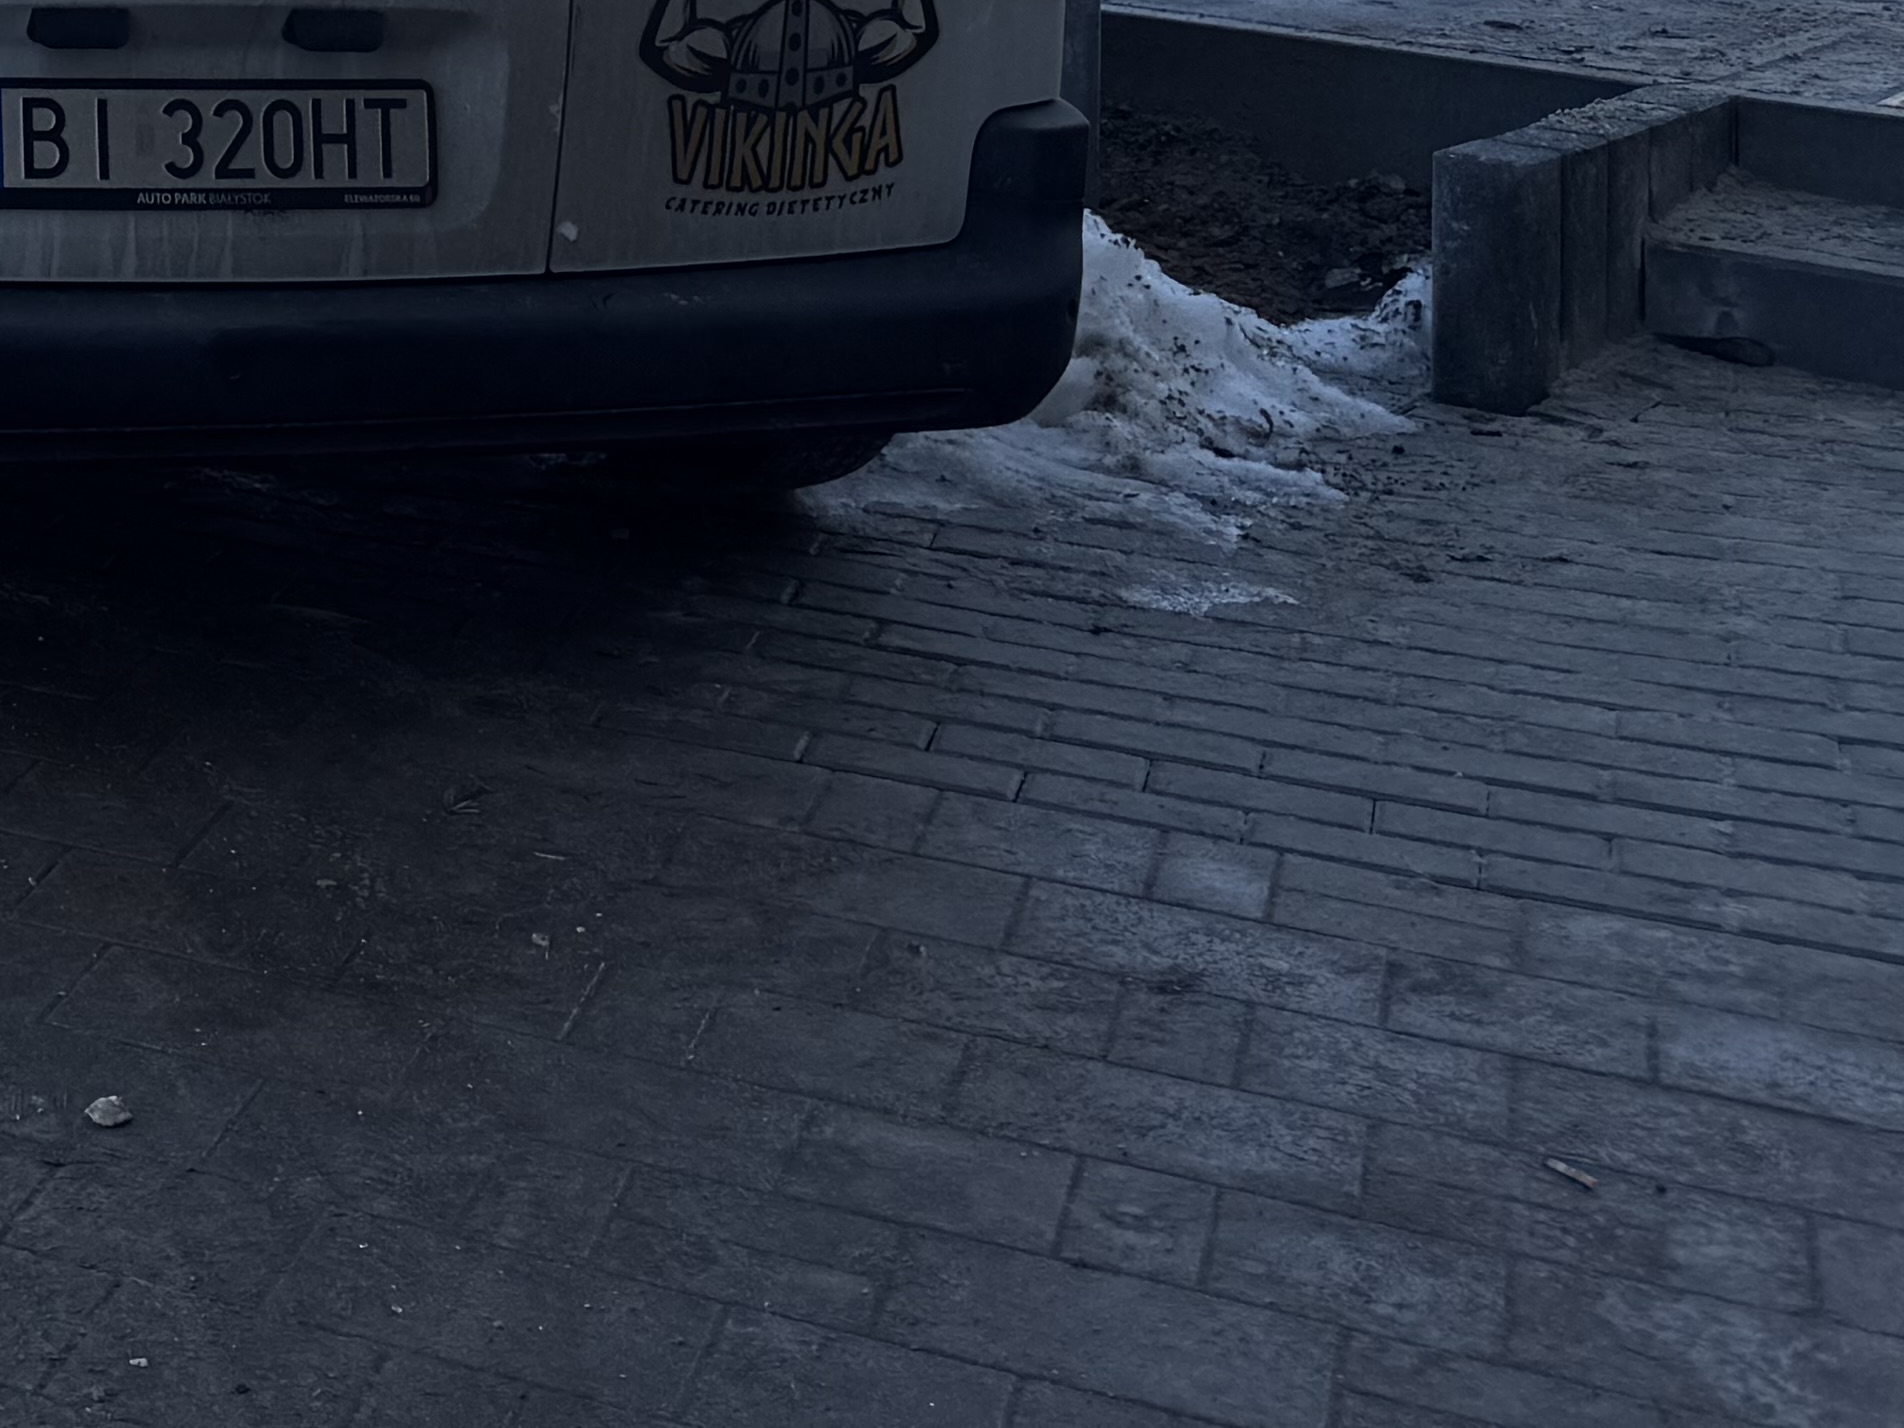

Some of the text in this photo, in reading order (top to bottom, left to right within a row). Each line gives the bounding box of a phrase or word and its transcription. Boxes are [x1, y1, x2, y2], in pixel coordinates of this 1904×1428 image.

[21, 96, 408, 181] BI 320HT
[668, 84, 904, 192] VIKINGA
[136, 191, 171, 205] AUTO
[174, 191, 207, 206] PARK
[664, 183, 898, 218] CATERING DIETETYCZNY
